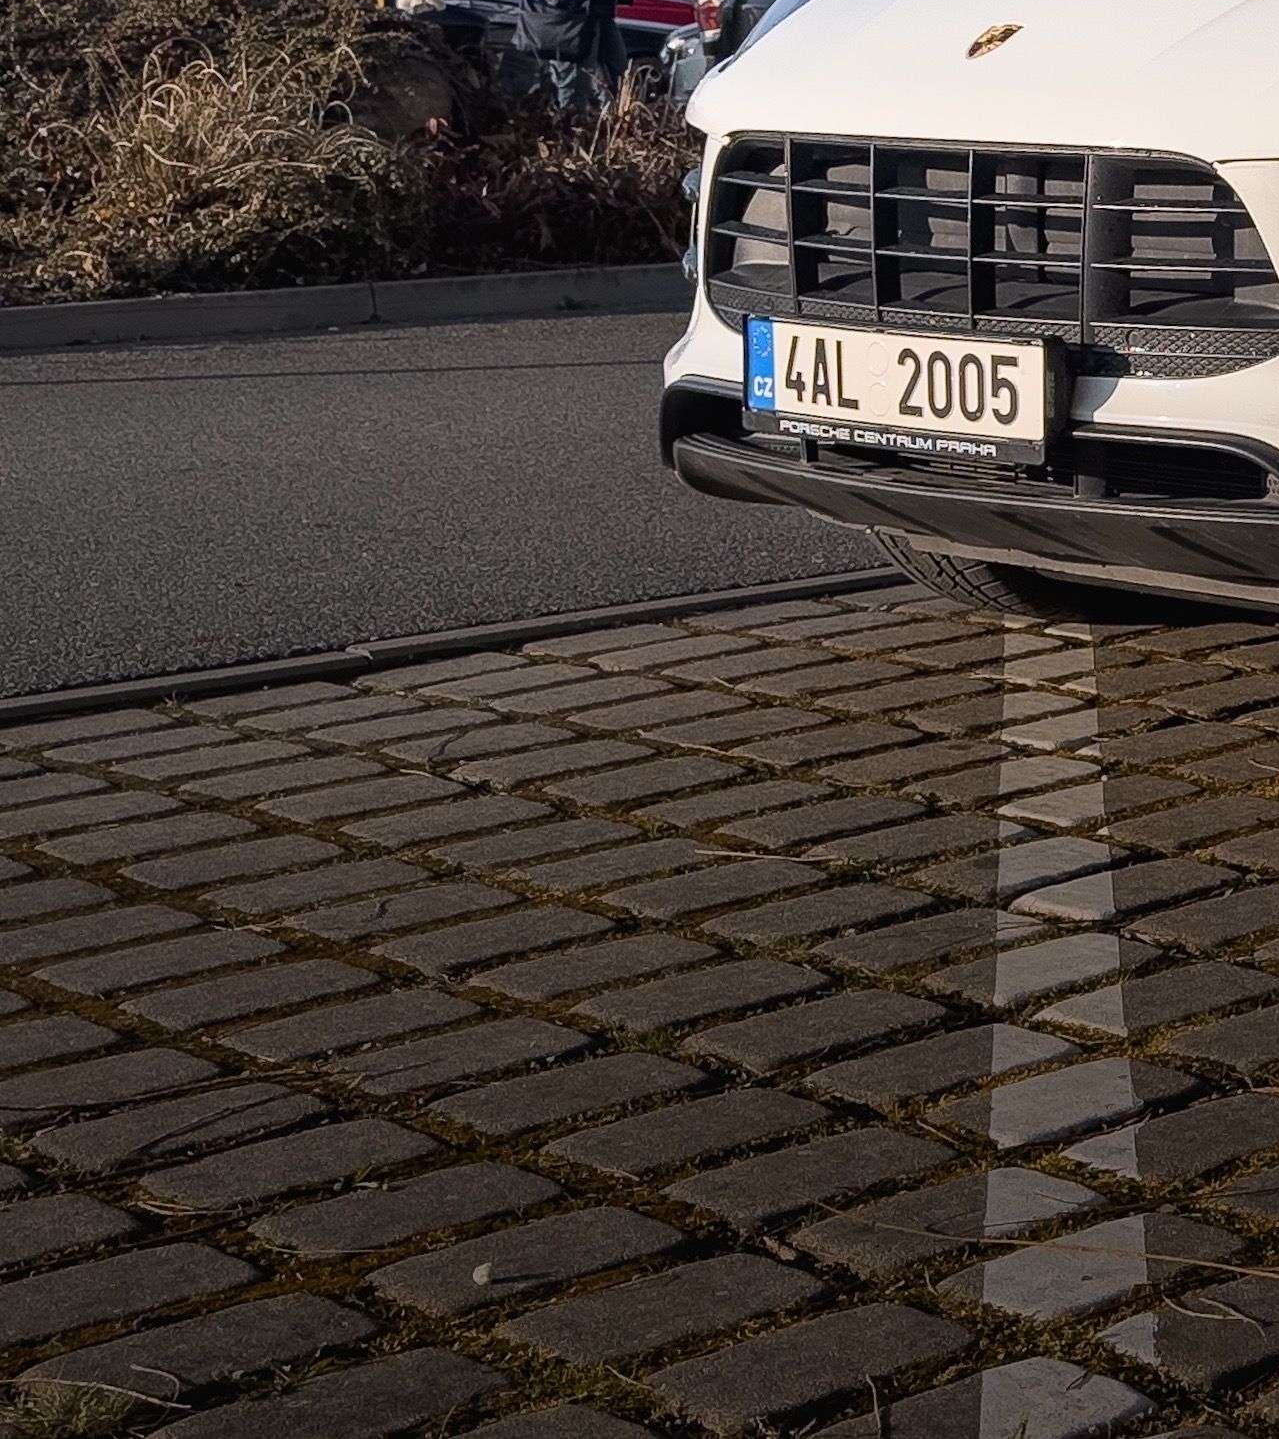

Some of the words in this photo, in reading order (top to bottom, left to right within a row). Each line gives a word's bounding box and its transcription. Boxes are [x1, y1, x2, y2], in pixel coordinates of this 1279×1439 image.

[753, 375, 774, 399] CZ
[784, 335, 860, 410] 4AL
[897, 348, 1020, 425] 2005
[779, 419, 850, 441] PORSCHE
[853, 429, 933, 451] CENTRUM
[935, 439, 997, 458] PRAHA
